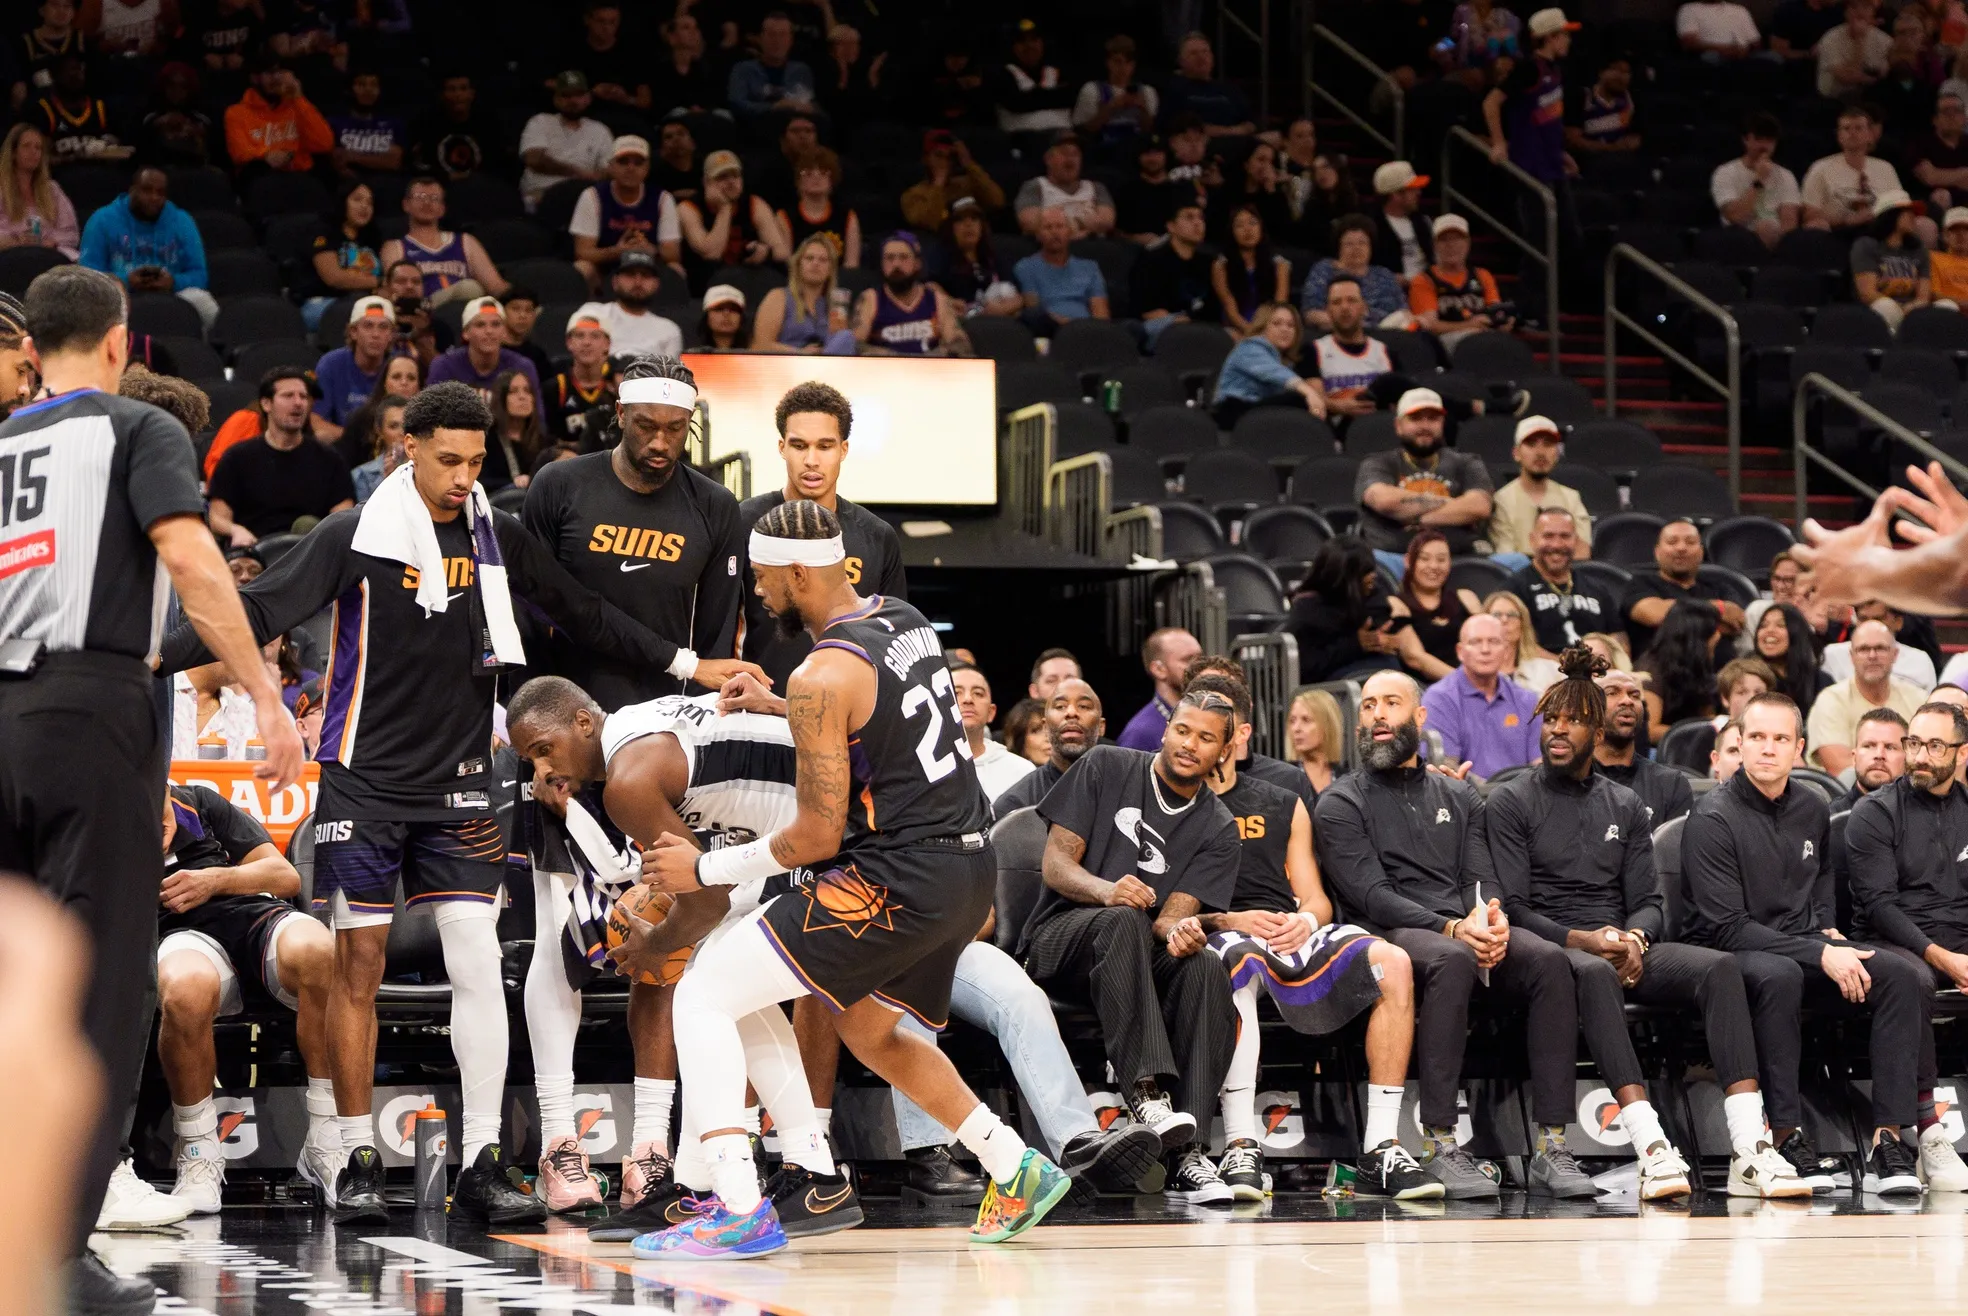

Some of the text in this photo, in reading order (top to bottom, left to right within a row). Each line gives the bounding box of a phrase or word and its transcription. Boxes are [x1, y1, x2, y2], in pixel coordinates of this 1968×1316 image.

[0, 446, 51, 528] 15
[0, 541, 50, 570] mirates
[588, 524, 686, 562] SUNS
[1535, 592, 1601, 616] SPRS
[884, 626, 942, 682] GOODWIN
